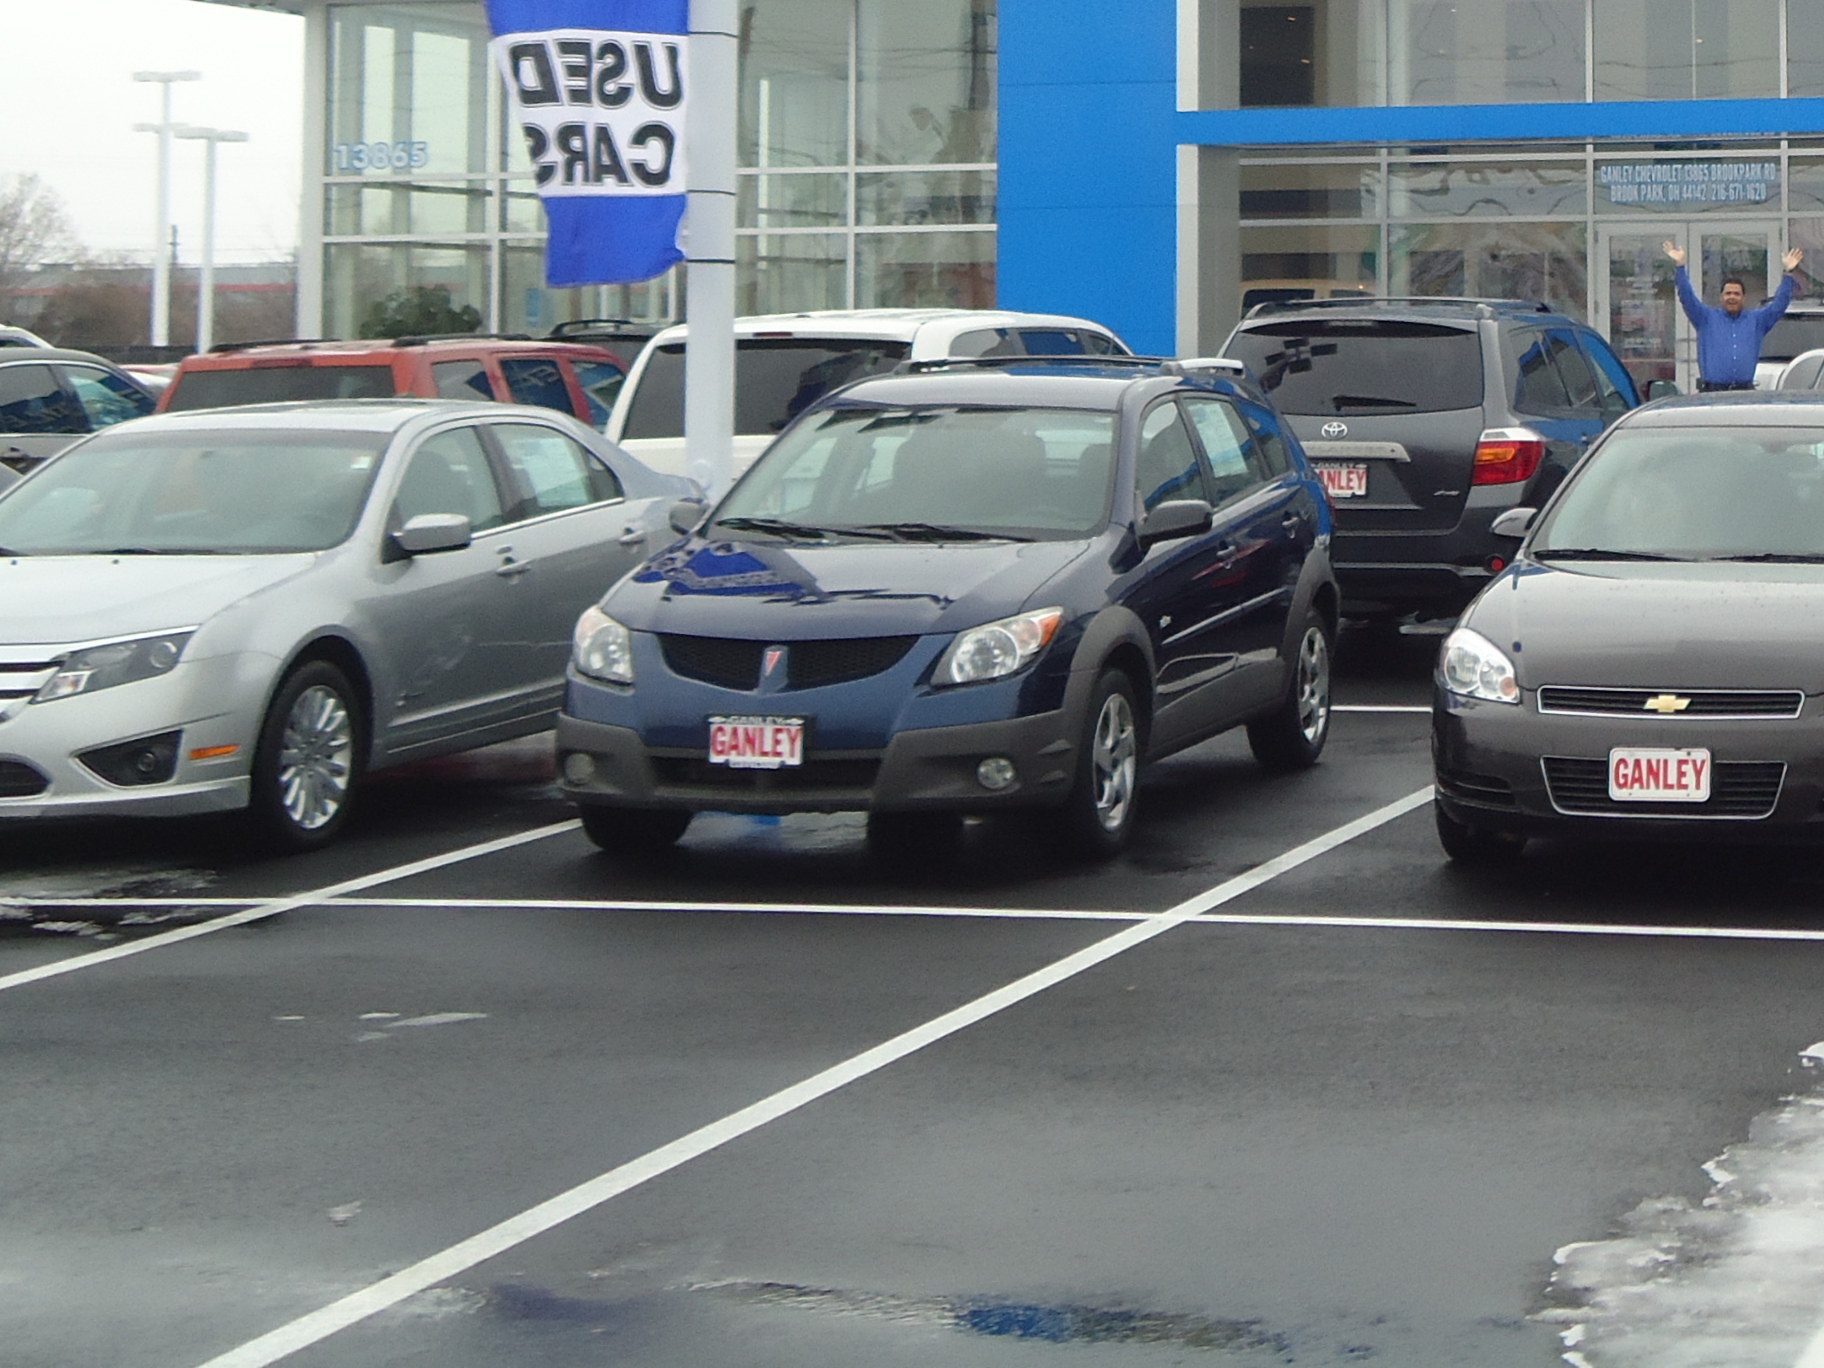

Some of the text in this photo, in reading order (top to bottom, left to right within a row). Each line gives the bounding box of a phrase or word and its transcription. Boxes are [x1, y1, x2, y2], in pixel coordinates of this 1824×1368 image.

[335, 141, 427, 169] 13865
[1601, 166, 1633, 183] GANLEY
[1635, 164, 1682, 182] CHEVROLET
[1611, 185, 1639, 202] BROOK
[1320, 469, 1366, 491] ANLEY
[711, 725, 803, 758] GANLEY
[1614, 757, 1706, 790] GANLEY
